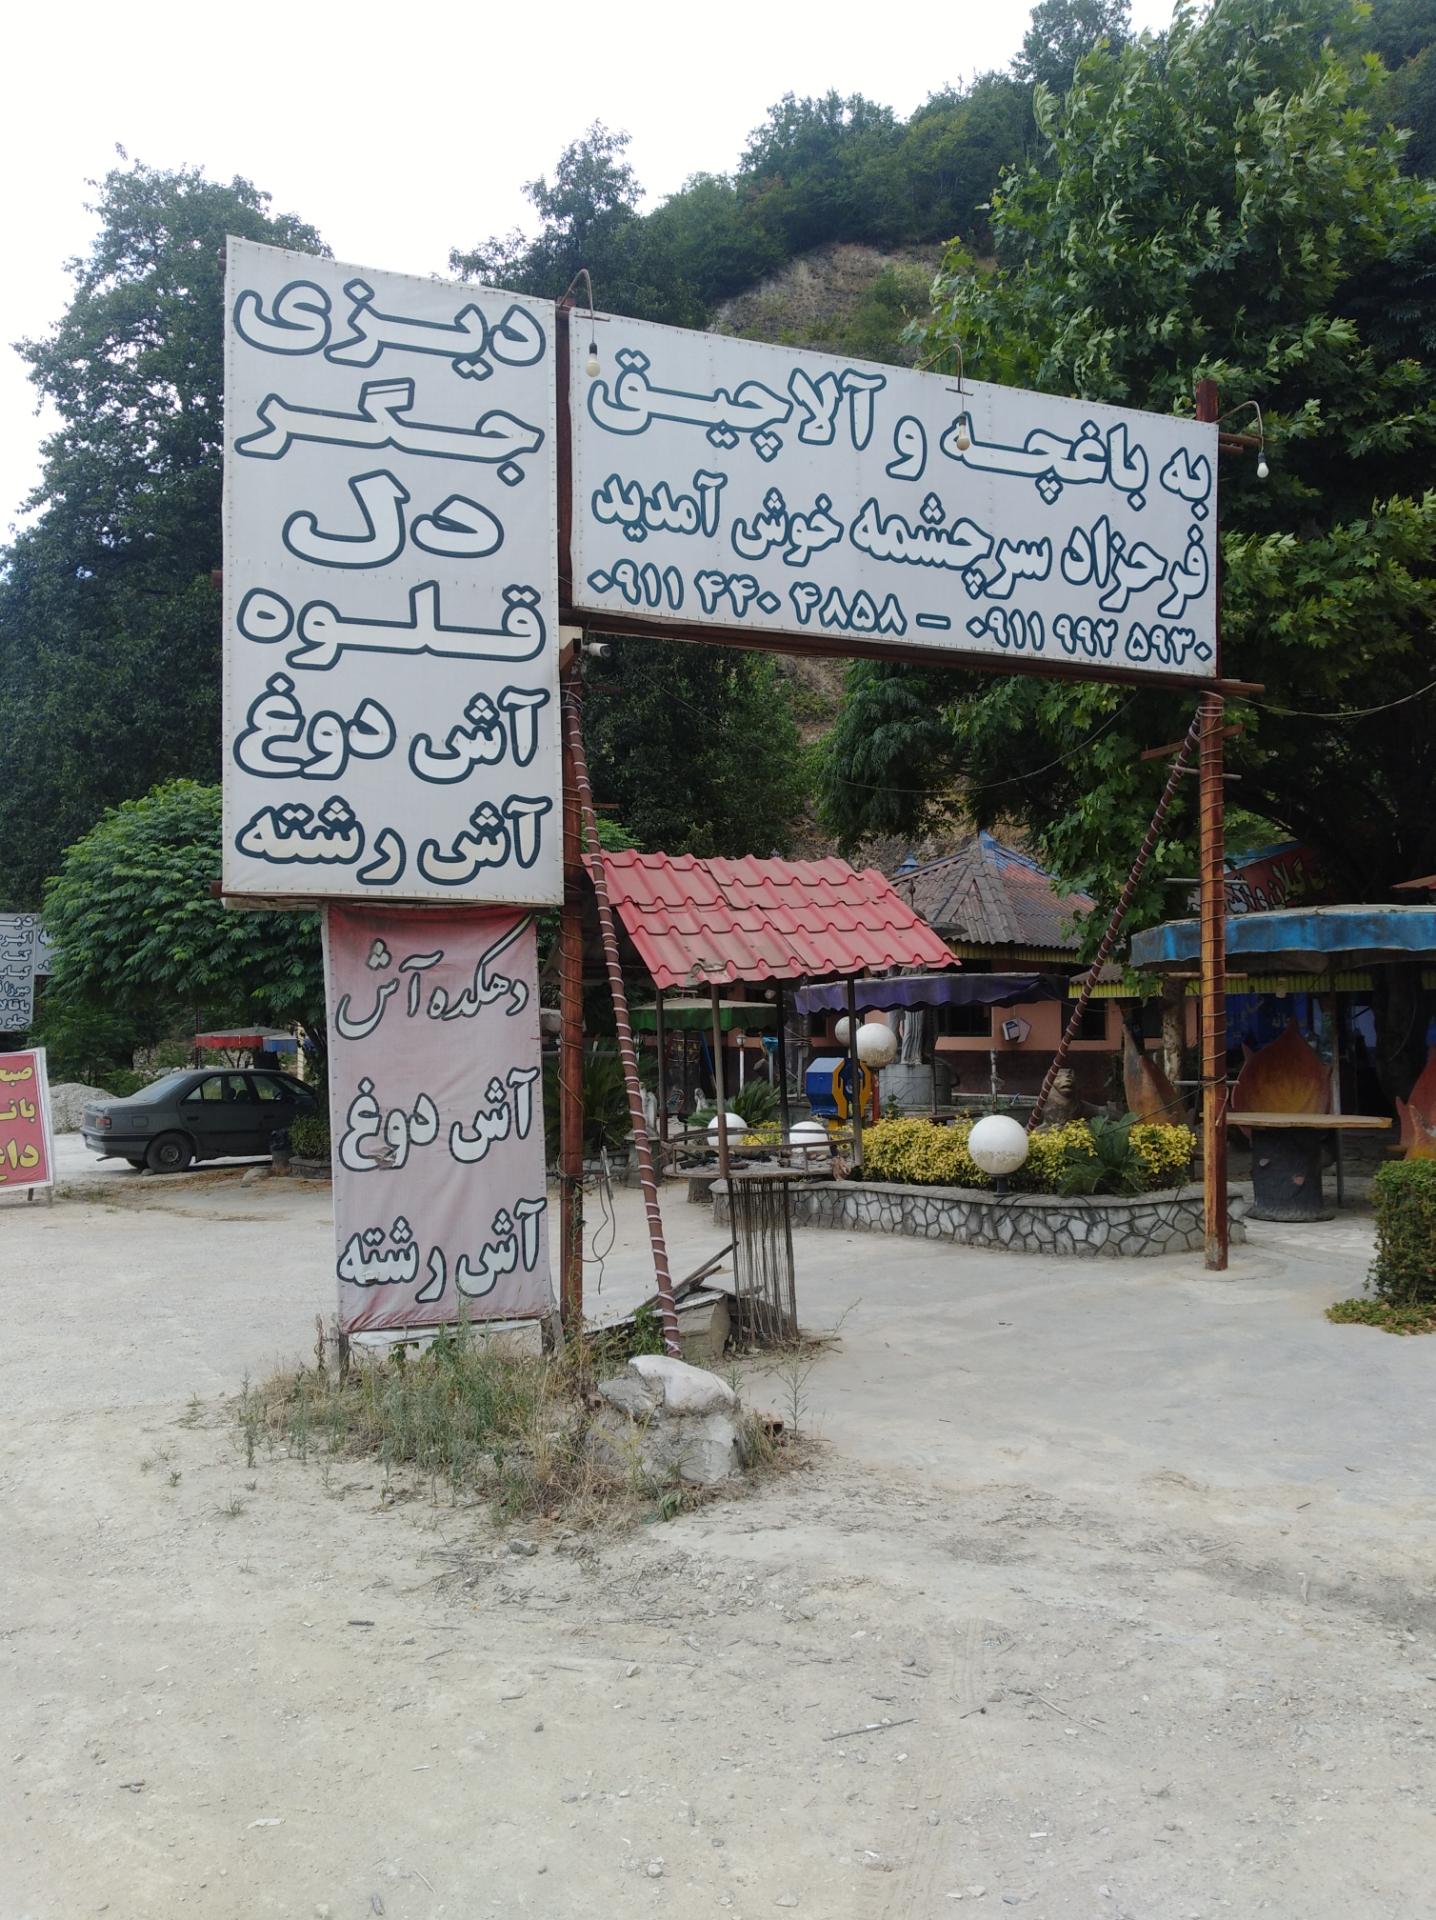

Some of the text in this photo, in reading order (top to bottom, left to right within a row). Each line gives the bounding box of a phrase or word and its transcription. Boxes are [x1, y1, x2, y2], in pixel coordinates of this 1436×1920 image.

[234, 278, 546, 380] دیزی
[234, 377, 545, 486] جگر
[587, 348, 1211, 521] به باغچه و آلاچیق
[282, 469, 504, 570] دل
[591, 469, 728, 543] آمدید
[731, 487, 844, 567] خوش
[1061, 514, 1209, 619] فرحزاد
[237, 580, 546, 671] قلوه
[233, 672, 550, 784] آش دوغ
[235, 794, 553, 885] آش رشته
[335, 912, 534, 1040] دهکده آش
[338, 1066, 540, 1172] آش دوغ
[336, 1198, 546, 1303] آش رشته
